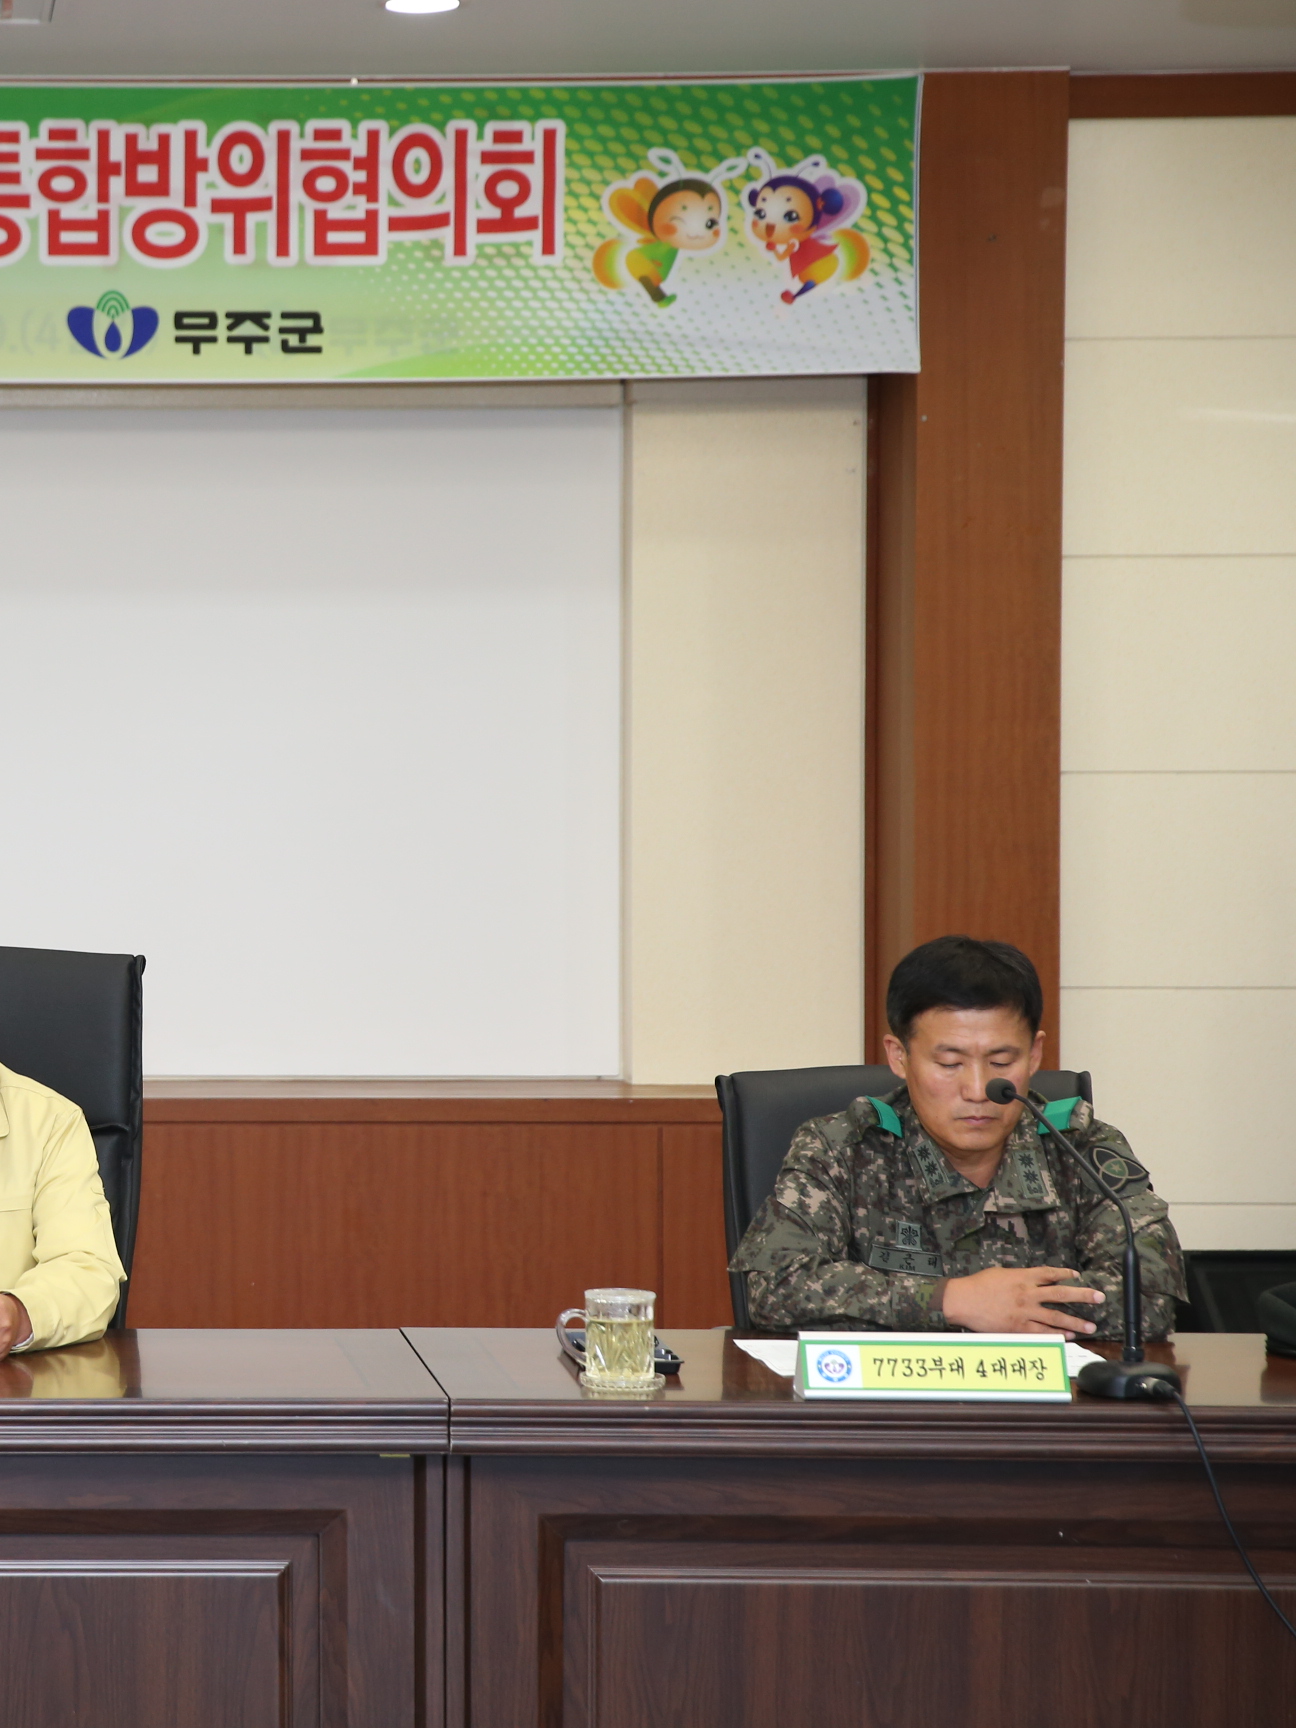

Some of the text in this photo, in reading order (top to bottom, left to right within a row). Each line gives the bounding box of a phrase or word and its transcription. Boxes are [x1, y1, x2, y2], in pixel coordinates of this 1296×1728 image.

[172, 310, 325, 356] 무주군
[872, 1356, 965, 1379] 7733부대
[975, 1356, 1048, 1381] 4대대장
